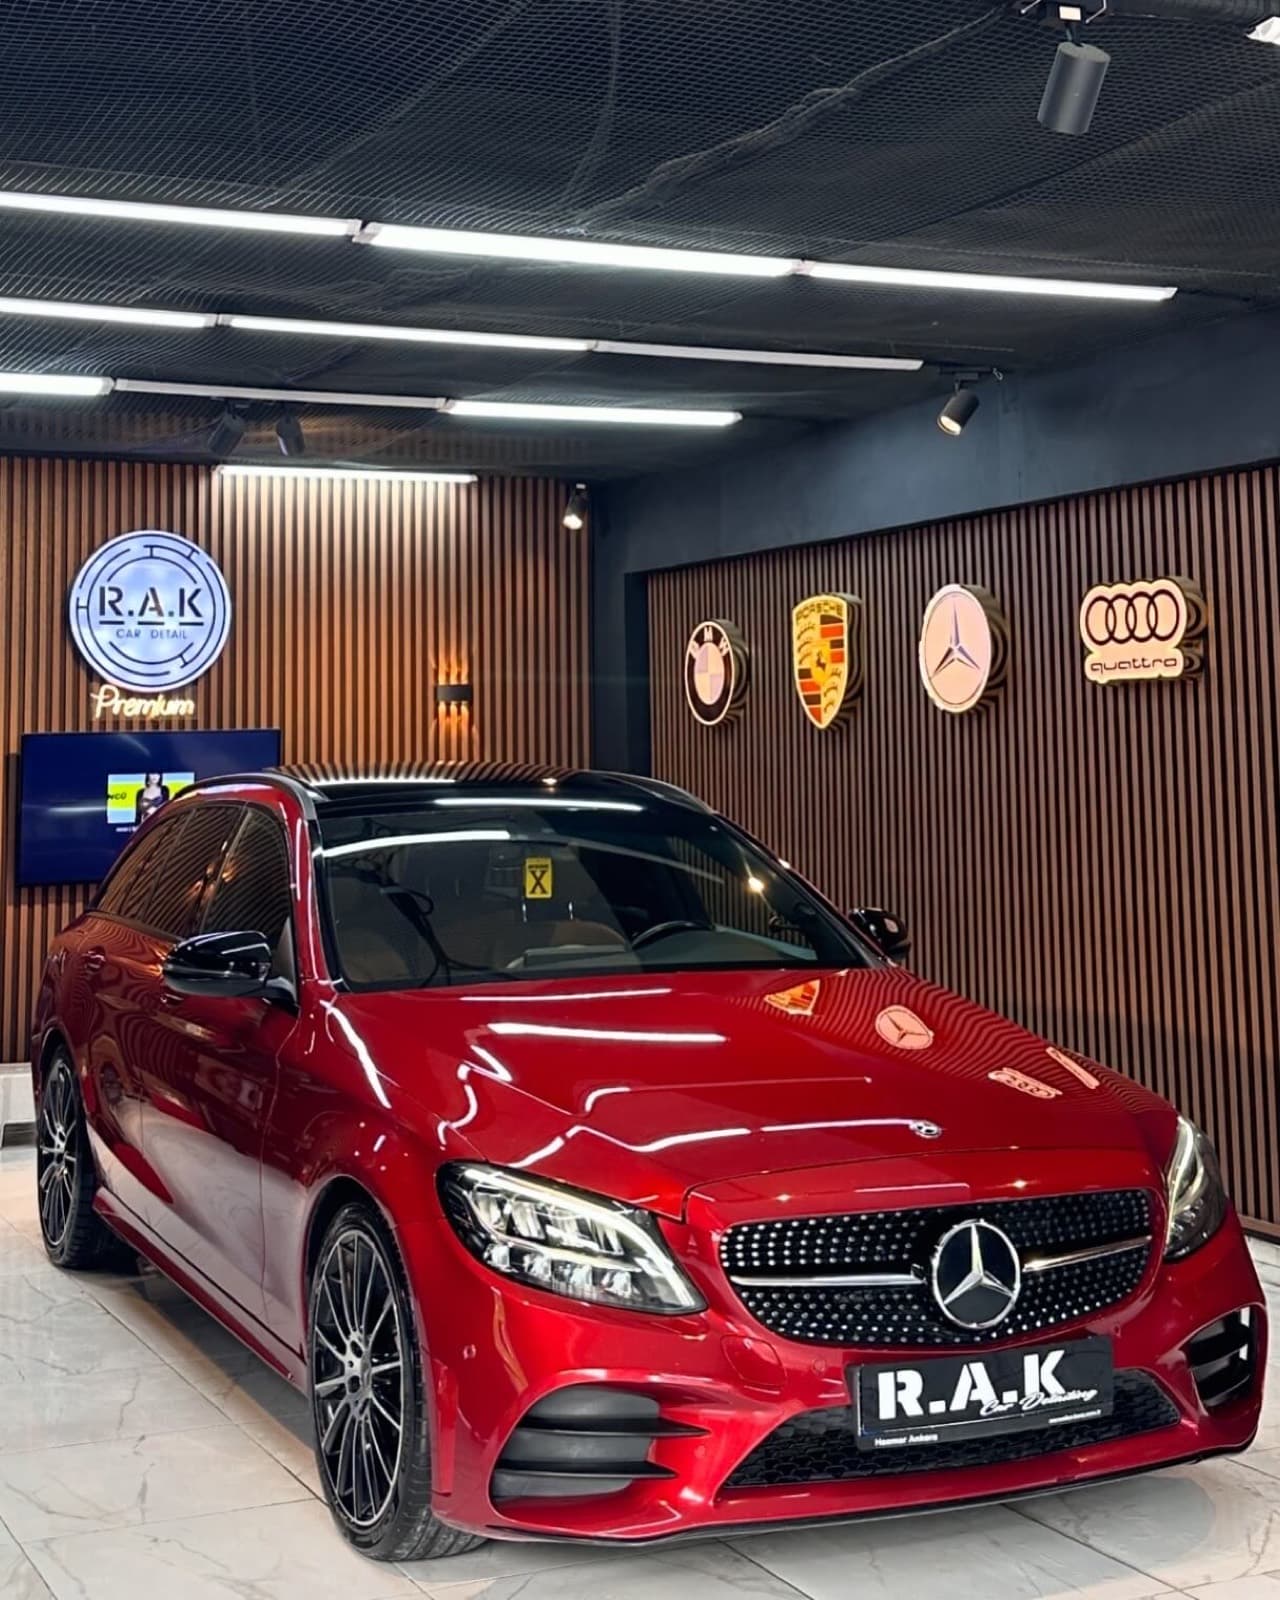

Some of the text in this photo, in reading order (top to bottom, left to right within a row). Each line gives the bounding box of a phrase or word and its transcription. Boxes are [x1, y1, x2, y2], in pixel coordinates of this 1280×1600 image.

[99, 586, 202, 617] R.A.K
[115, 629, 187, 639] CAR DETAIL
[1090, 657, 1177, 675] quattro
[90, 684, 195, 718] Premium
[878, 1350, 1065, 1420] R.A.K
